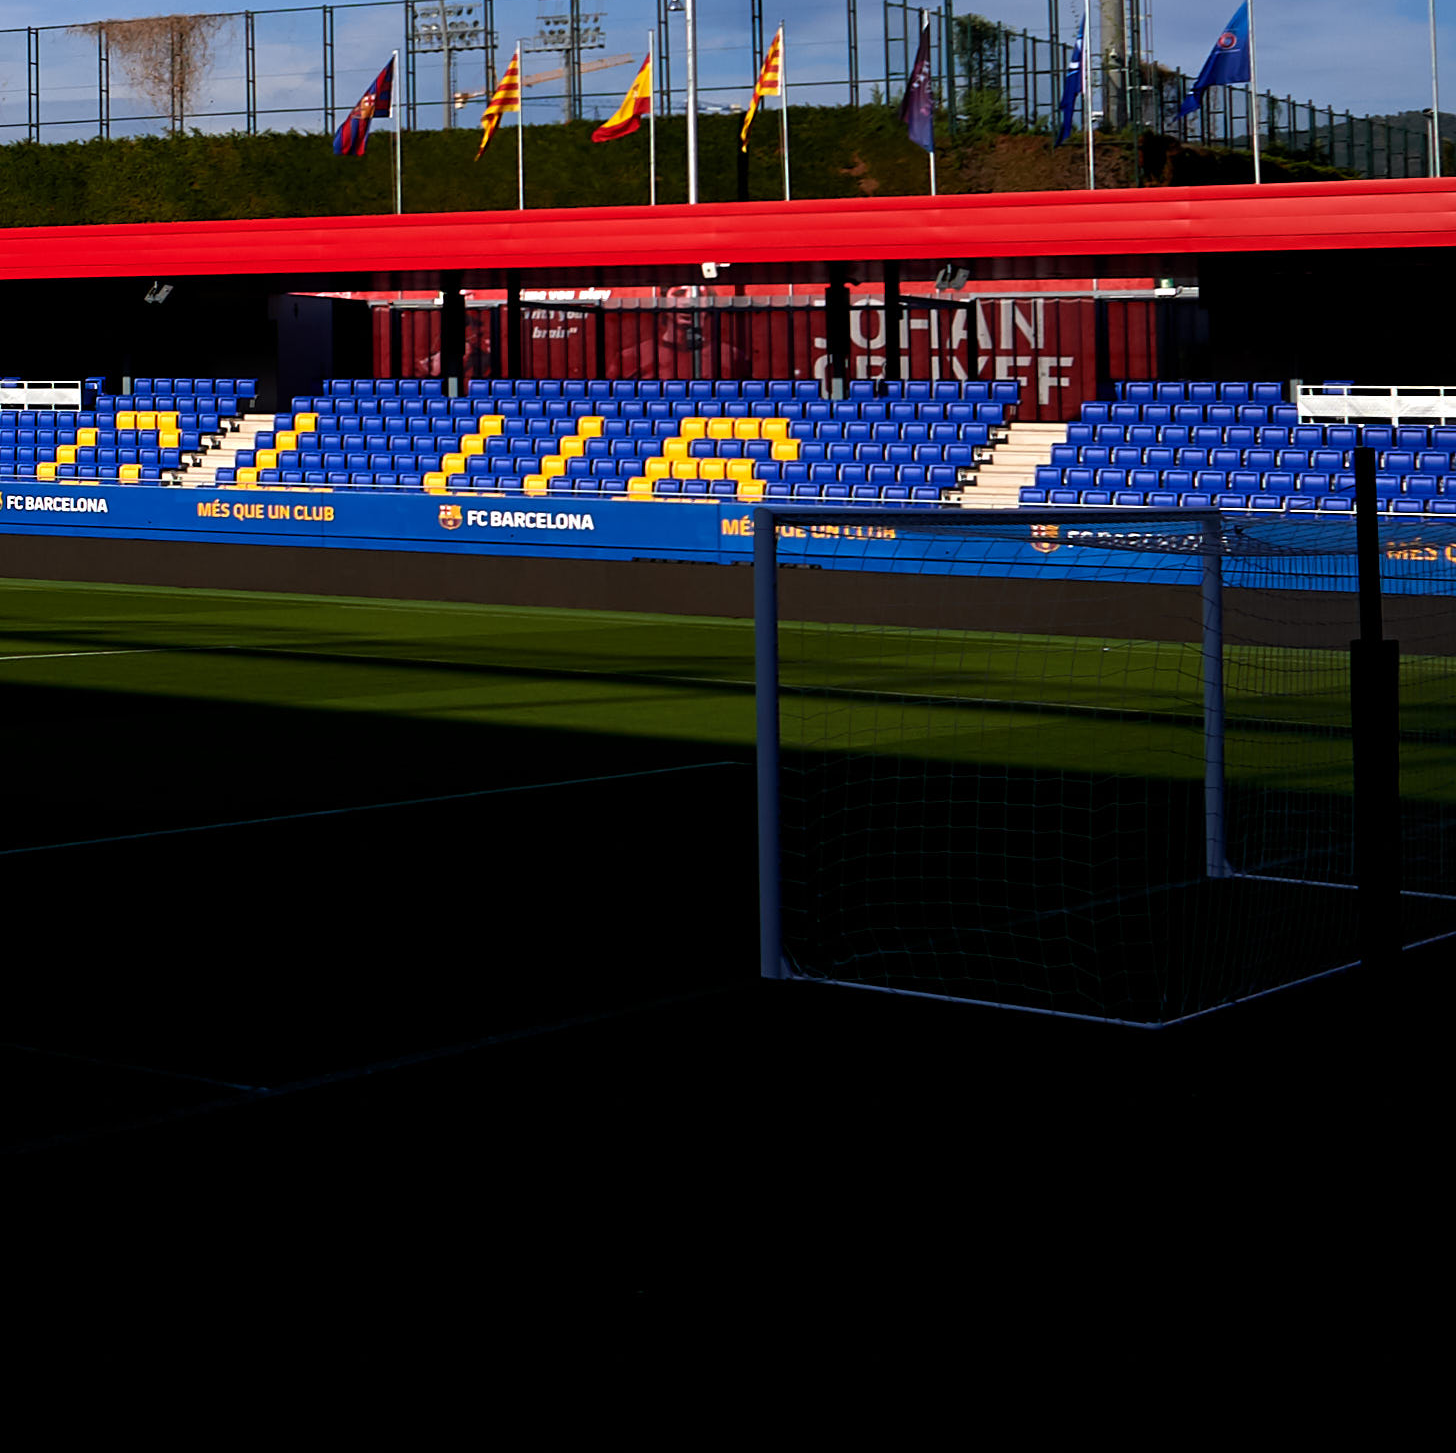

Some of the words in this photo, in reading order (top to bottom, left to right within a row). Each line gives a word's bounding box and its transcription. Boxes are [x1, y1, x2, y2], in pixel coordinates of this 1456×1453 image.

[814, 298, 1044, 349] OHAN
[7, 495, 23, 510] FC
[25, 496, 108, 513] BARCELONA
[197, 498, 230, 518] MÉS
[233, 503, 264, 521] QUE
[267, 504, 290, 520] UN
[293, 505, 334, 522] CLUB
[467, 509, 488, 527] FC
[490, 510, 594, 531] BARCELONA
[721, 515, 755, 536] MÉ
